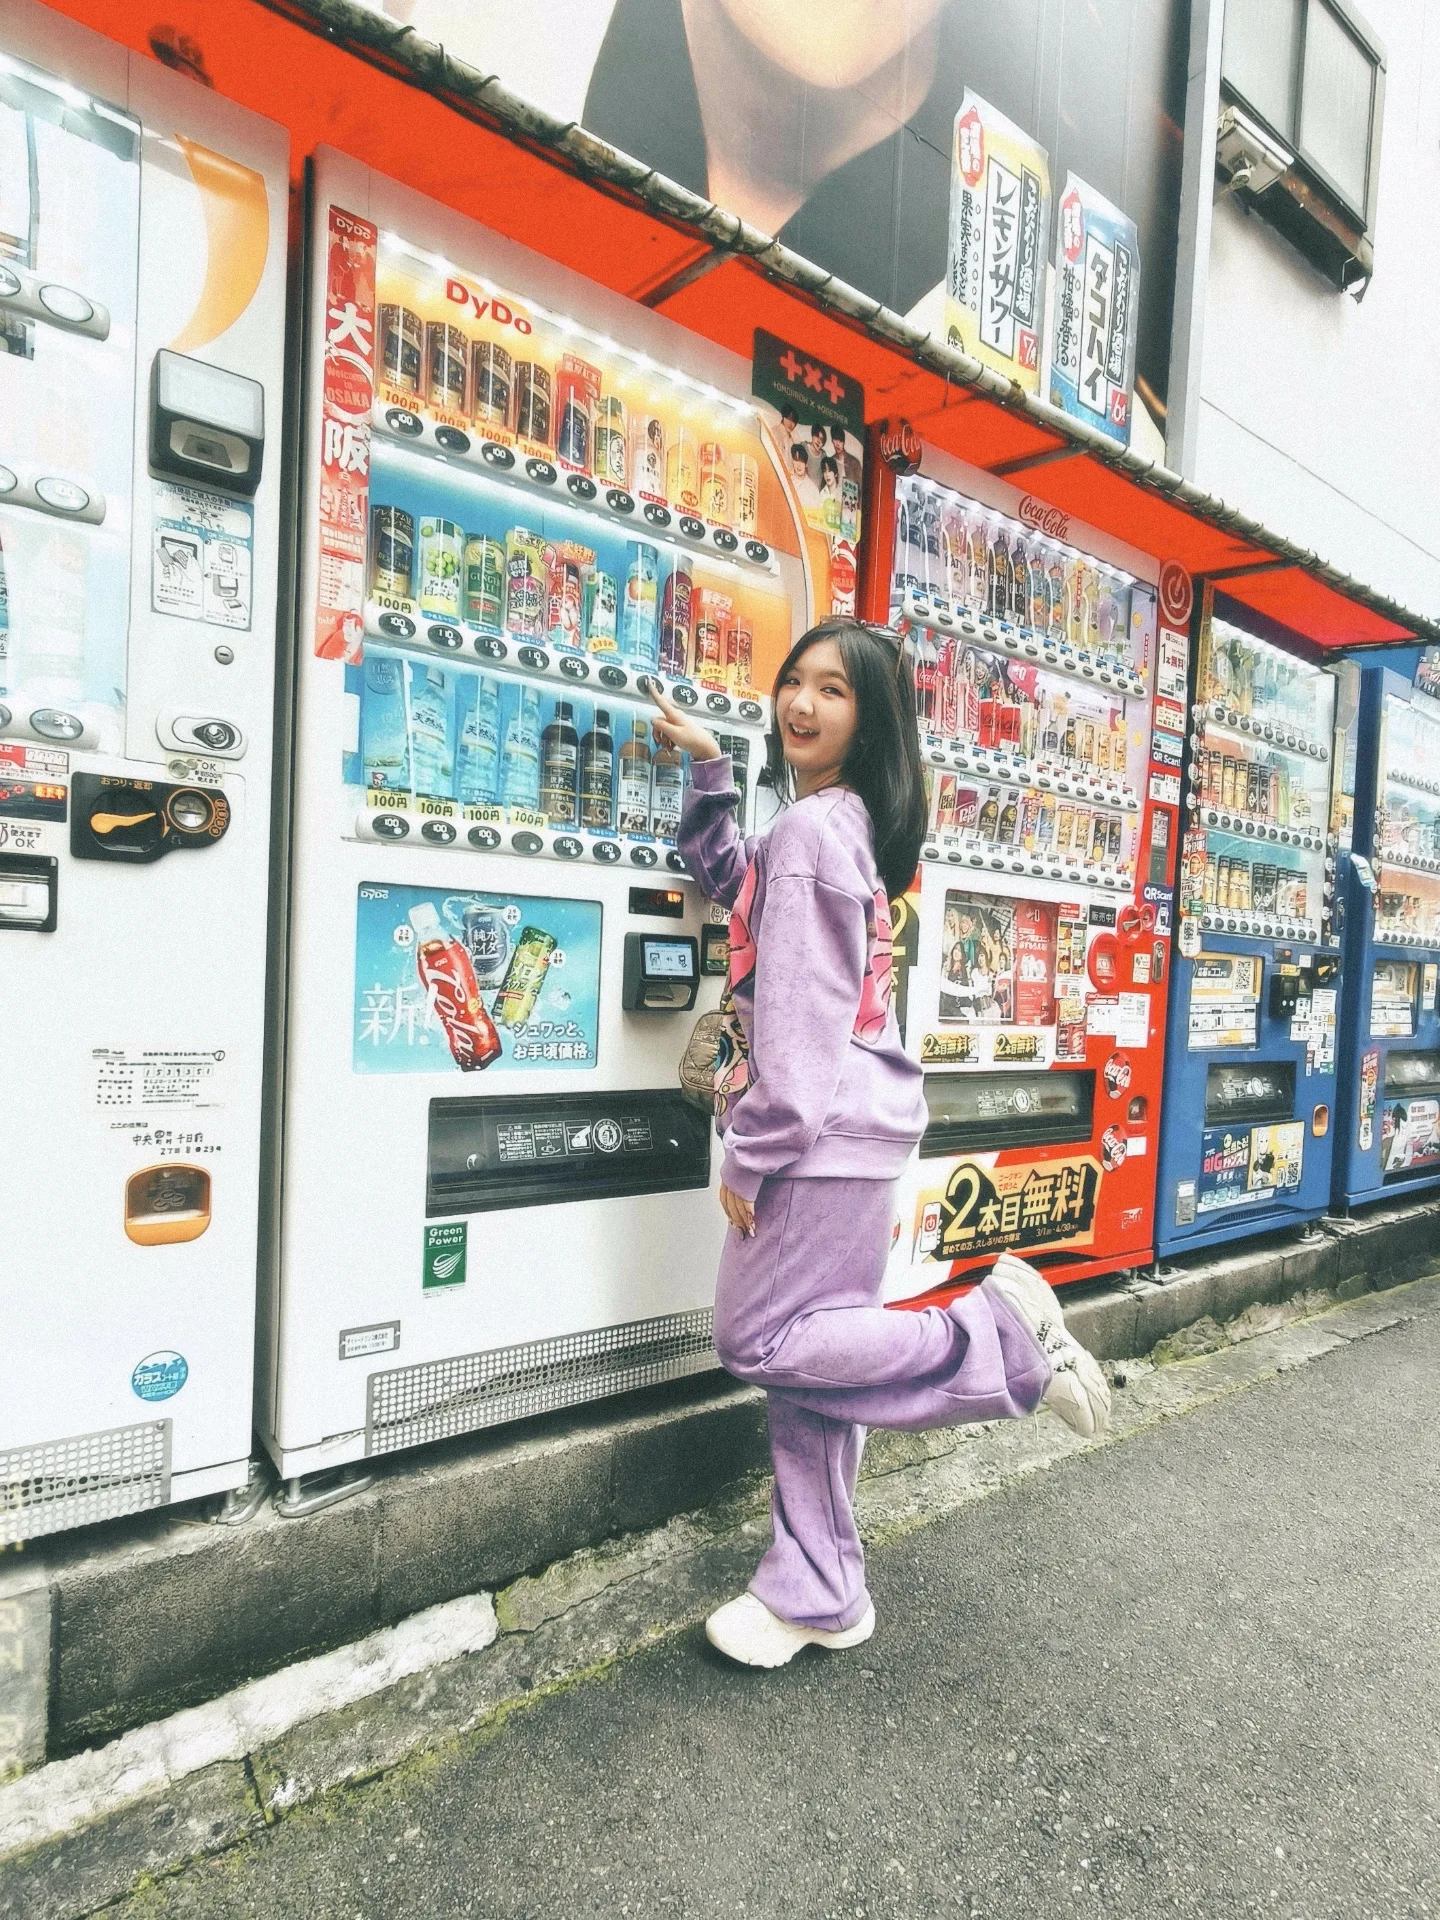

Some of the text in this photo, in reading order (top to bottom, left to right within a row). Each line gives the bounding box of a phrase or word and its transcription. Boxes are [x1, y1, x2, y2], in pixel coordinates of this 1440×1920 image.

[336, 217, 371, 240] DyDo
[1016, 177, 1038, 317] こだわり酒場
[989, 170, 1017, 343] レモンサワー
[446, 278, 533, 335] DyDo
[1109, 250, 1128, 378] こだわり酒場
[1084, 251, 1109, 401] タコハイ
[326, 386, 370, 408] OSAKA
[385, 390, 419, 413] 100円
[434, 411, 466, 431] 100円
[480, 427, 512, 447] 100円
[1018, 495, 1069, 541] Coca-Cola
[378, 596, 412, 613] 100円
[201, 761, 216, 771] OK
[1153, 751, 1181, 767] QR Scan!
[101, 777, 153, 790] おつり・返却
[374, 794, 407, 809] 100円
[421, 802, 453, 817] 100円
[470, 809, 500, 822] 100円
[515, 811, 544, 827] 100円
[15, 838, 35, 848] OK
[360, 889, 389, 900] DyDo
[1143, 887, 1173, 901] QR Scan!
[1091, 911, 1113, 924] 販売中
[473, 929, 498, 942] 純水
[470, 941, 504, 955] サイダー
[509, 963, 544, 983] メロン
[514, 1022, 585, 1038] シュワっと、
[514, 1044, 593, 1060] お手頃価格。
[132, 1133, 152, 1146] 中央
[1204, 1152, 1223, 1173] BIG
[943, 1165, 1088, 1243] 2本目無料
[429, 1226, 463, 1237] Green
[428, 1235, 463, 1247] Power
